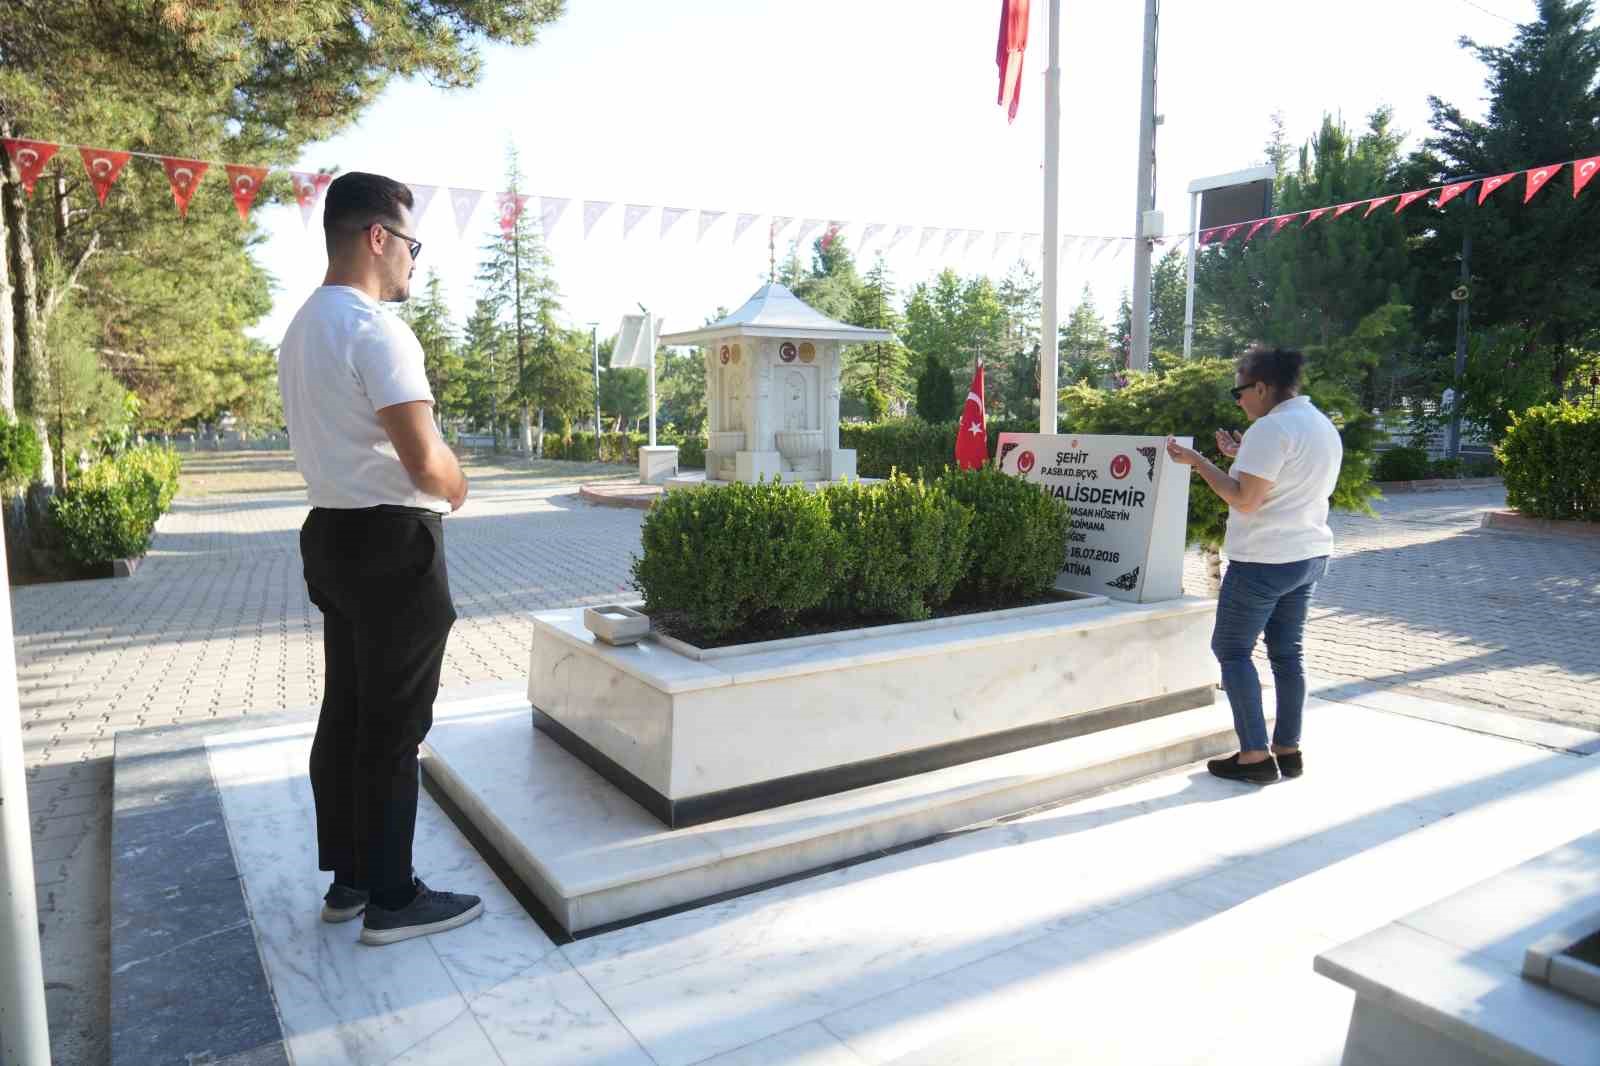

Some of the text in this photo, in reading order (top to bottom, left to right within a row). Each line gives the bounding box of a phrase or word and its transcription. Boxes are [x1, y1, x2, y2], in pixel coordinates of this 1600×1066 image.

[1055, 450, 1089, 466] ŞEHİT
[1095, 507, 1130, 521] HÜSEYİN
[1062, 561, 1092, 577] ATİHA
